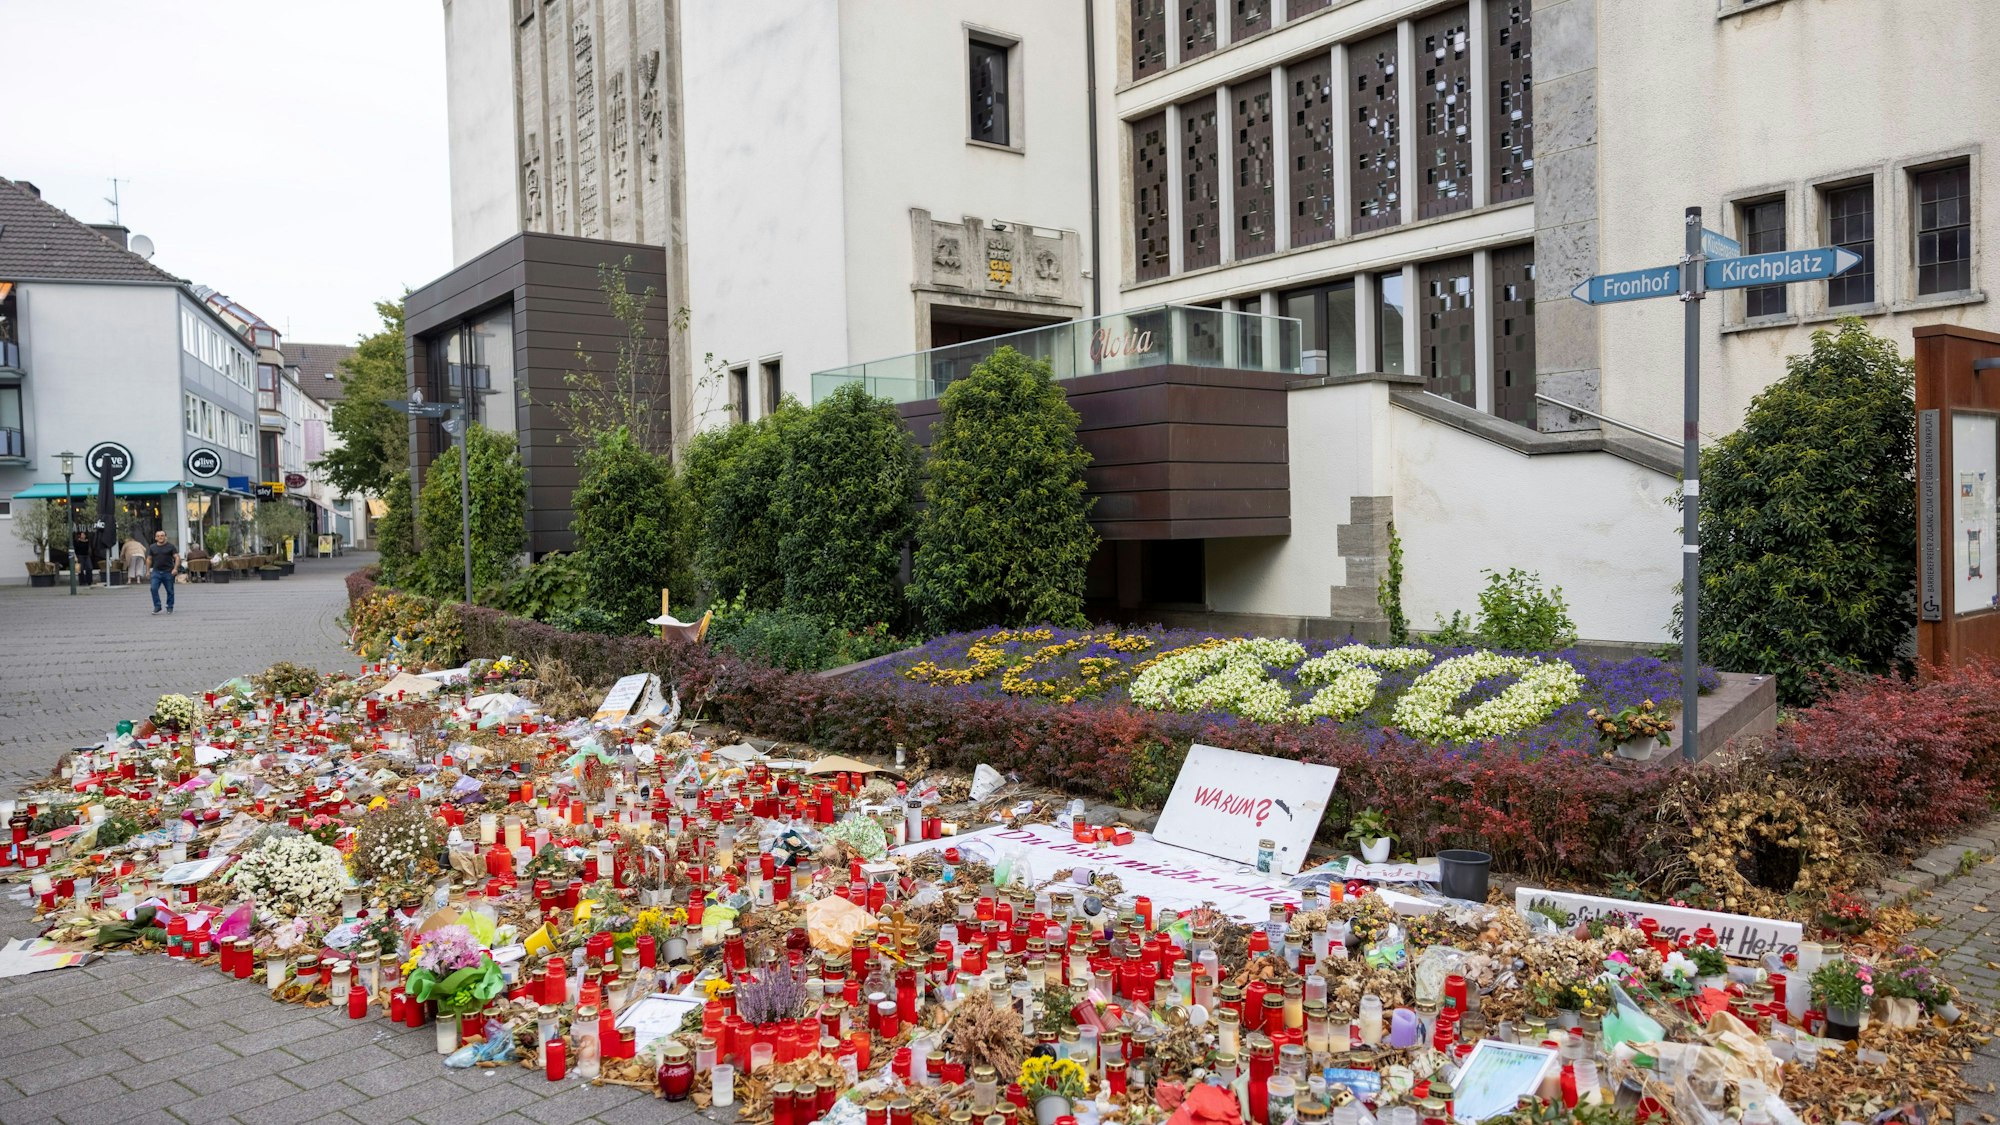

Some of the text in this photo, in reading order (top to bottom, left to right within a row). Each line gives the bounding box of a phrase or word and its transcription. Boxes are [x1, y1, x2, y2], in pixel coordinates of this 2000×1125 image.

[1722, 254, 1822, 282] Kirchplatz
[1603, 271, 1670, 297] Fronhof
[1089, 327, 1154, 365] Gloria
[1925, 413, 1933, 447] PARKPLATZ
[1925, 449, 1933, 462] DEN
[257, 487, 271, 496] sky
[1926, 498, 1934, 513] ZUM
[1926, 514, 1934, 541] ZUGANG
[1194, 785, 1272, 827] WARUM?
[991, 830, 1050, 845] Du
[1047, 843, 1123, 860] bist
[1113, 860, 1220, 884] nicht
